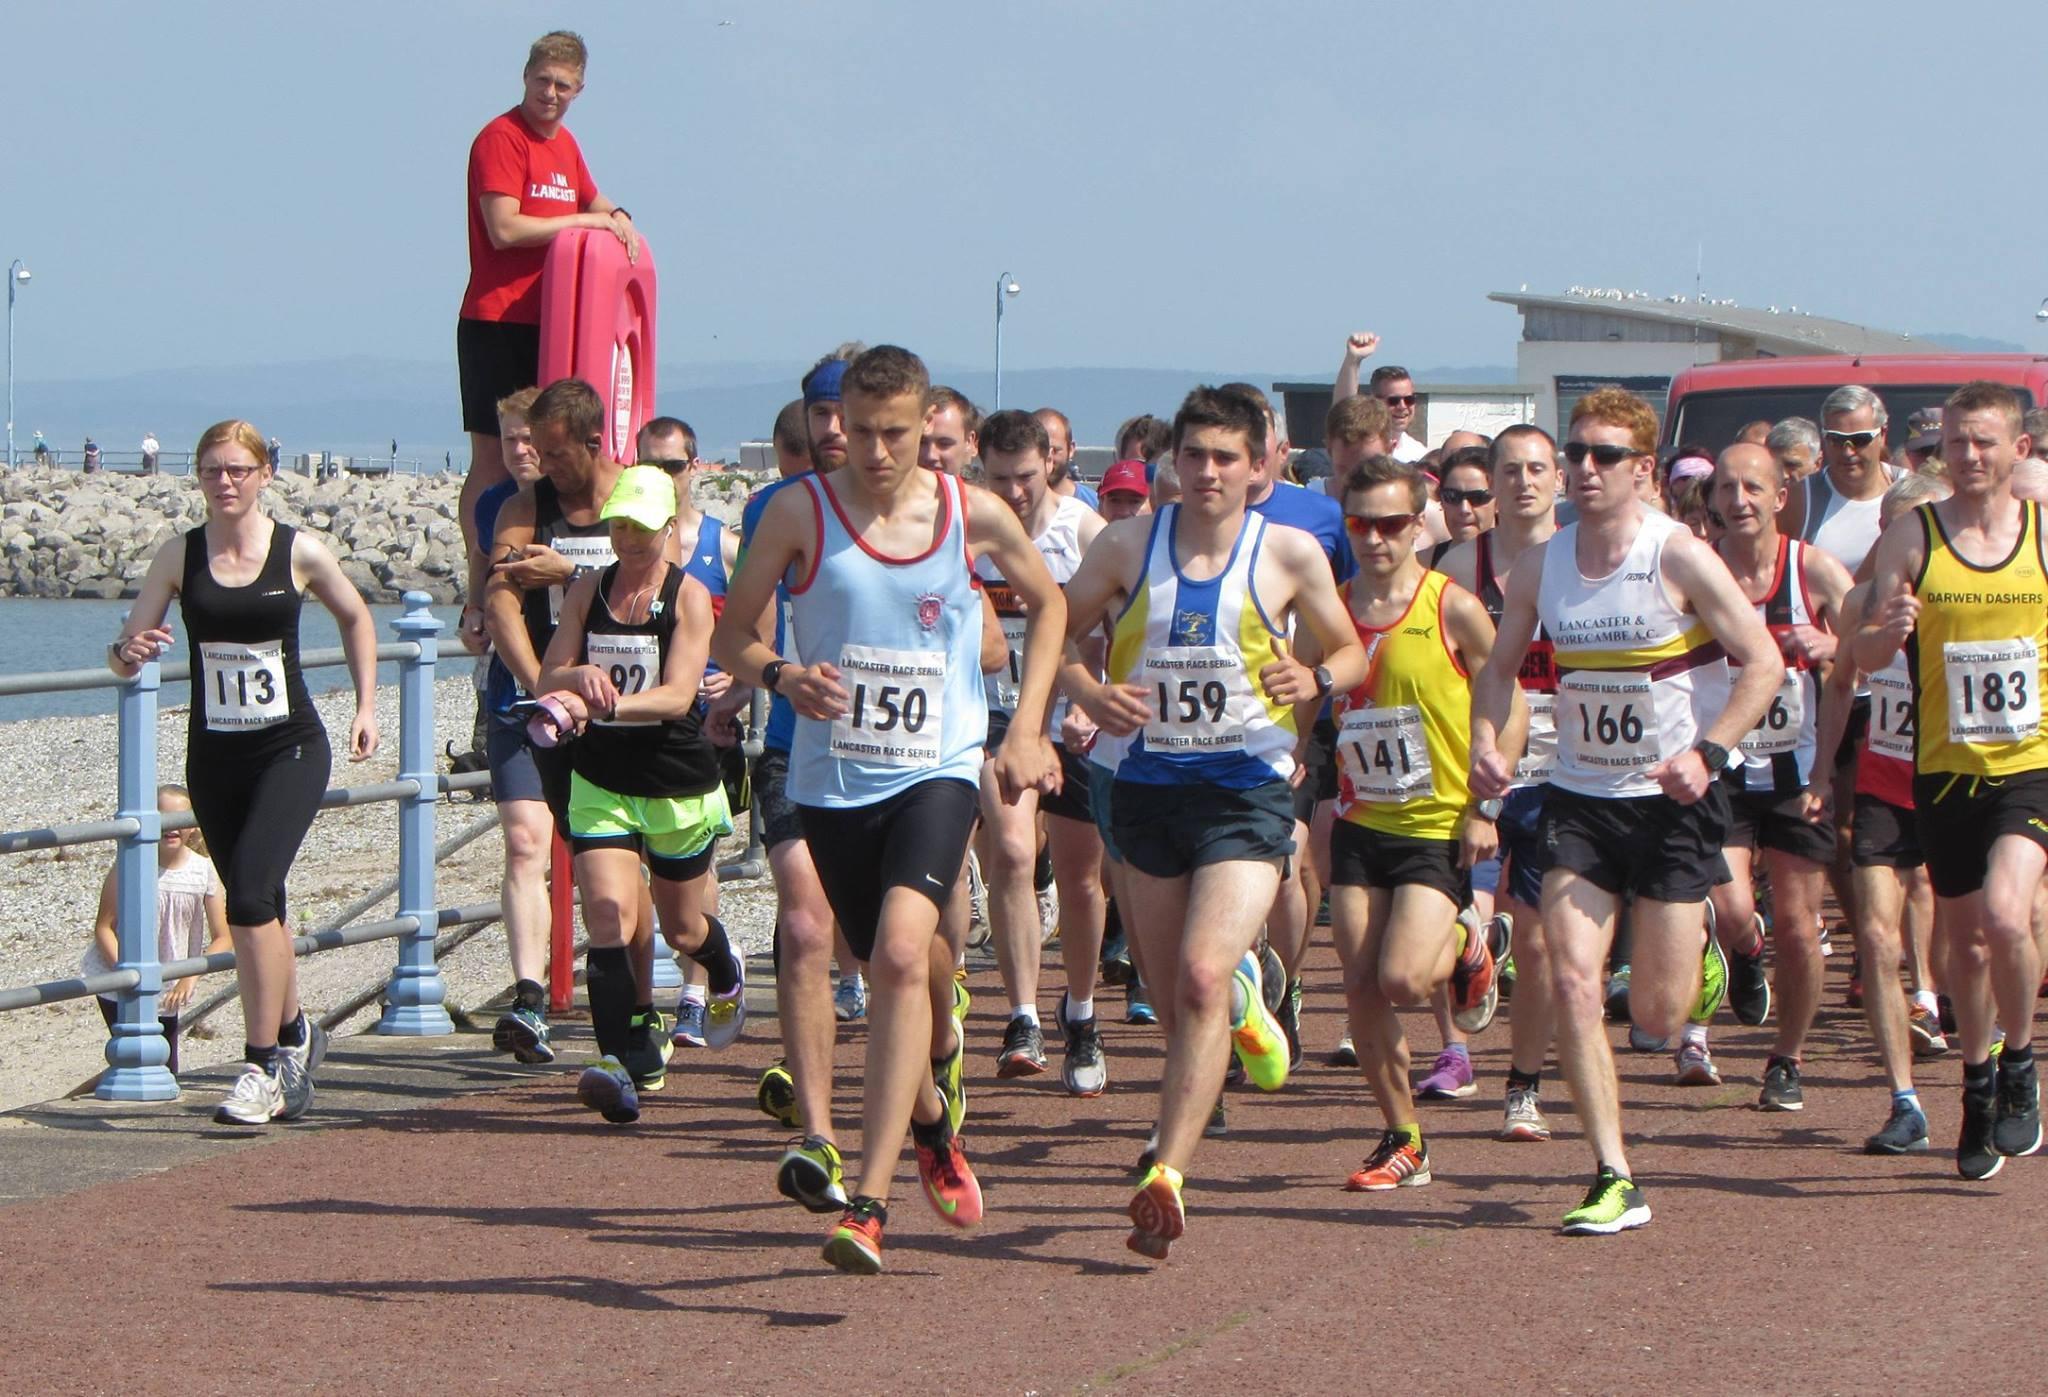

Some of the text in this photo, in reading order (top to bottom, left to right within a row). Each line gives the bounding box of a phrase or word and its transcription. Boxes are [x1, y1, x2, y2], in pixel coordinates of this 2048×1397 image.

[1927, 592, 2043, 605] DARWEN DASHERS
[1559, 615, 1645, 631] LANCASTER &
[1186, 660, 1208, 670] RACE
[1210, 658, 1238, 669] SERIES
[1946, 653, 1990, 664] LANCASTER
[1992, 652, 2011, 662] RACE
[842, 659, 944, 676] LANCASTER RACE SERIES
[216, 668, 276, 707] 113
[1601, 684, 1621, 694] RACE
[1622, 684, 1650, 693] SERIES
[1963, 670, 2028, 714] 183
[852, 683, 928, 734] 150
[1158, 680, 1227, 724] 159
[1579, 703, 1643, 746] 166
[1951, 726, 1994, 736] LANCASTER
[1146, 734, 1244, 747] LANCASTER RACE SERIES
[833, 740, 937, 759] LANCASTER RACE SERIES
[1352, 738, 1411, 776] 141
[1610, 757, 1631, 767] RACE
